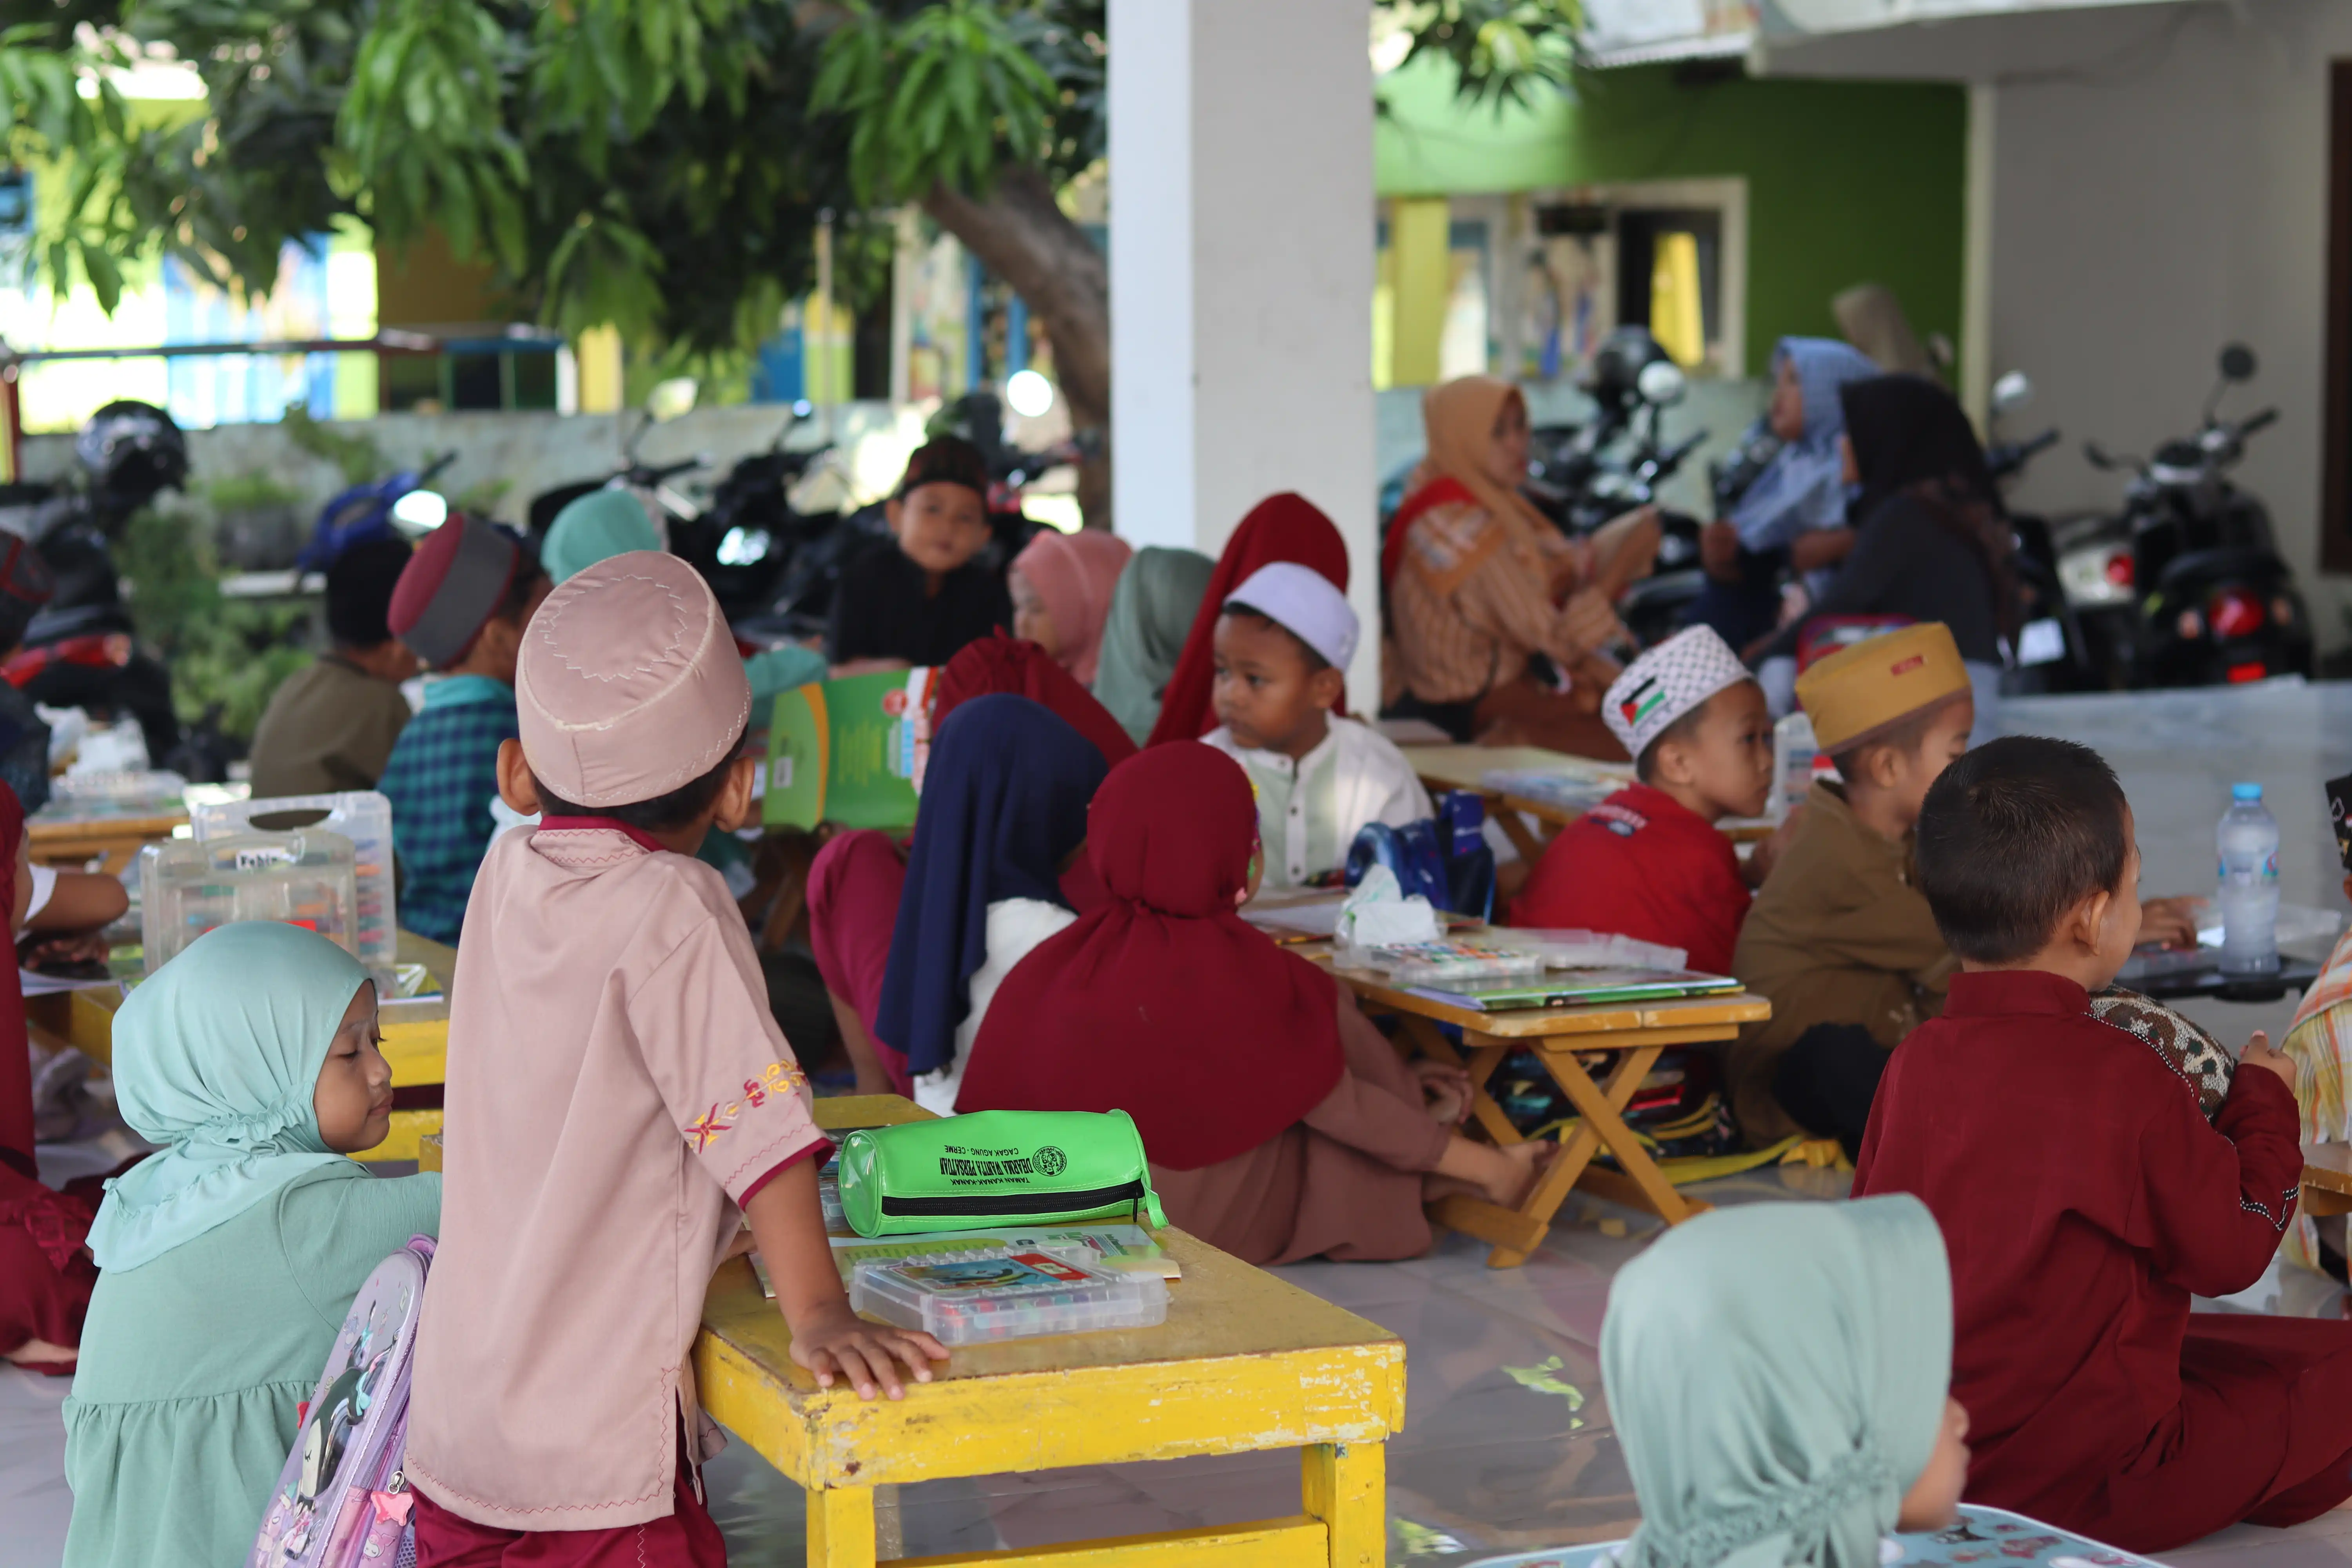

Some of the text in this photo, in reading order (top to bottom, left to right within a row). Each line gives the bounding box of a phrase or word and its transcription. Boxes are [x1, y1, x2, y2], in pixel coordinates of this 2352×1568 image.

[944, 1145, 965, 1154] CERME
[971, 1148, 993, 1156] AGUNG
[940, 1158, 1034, 1176] DHARMA WANITA PERSATUAN
